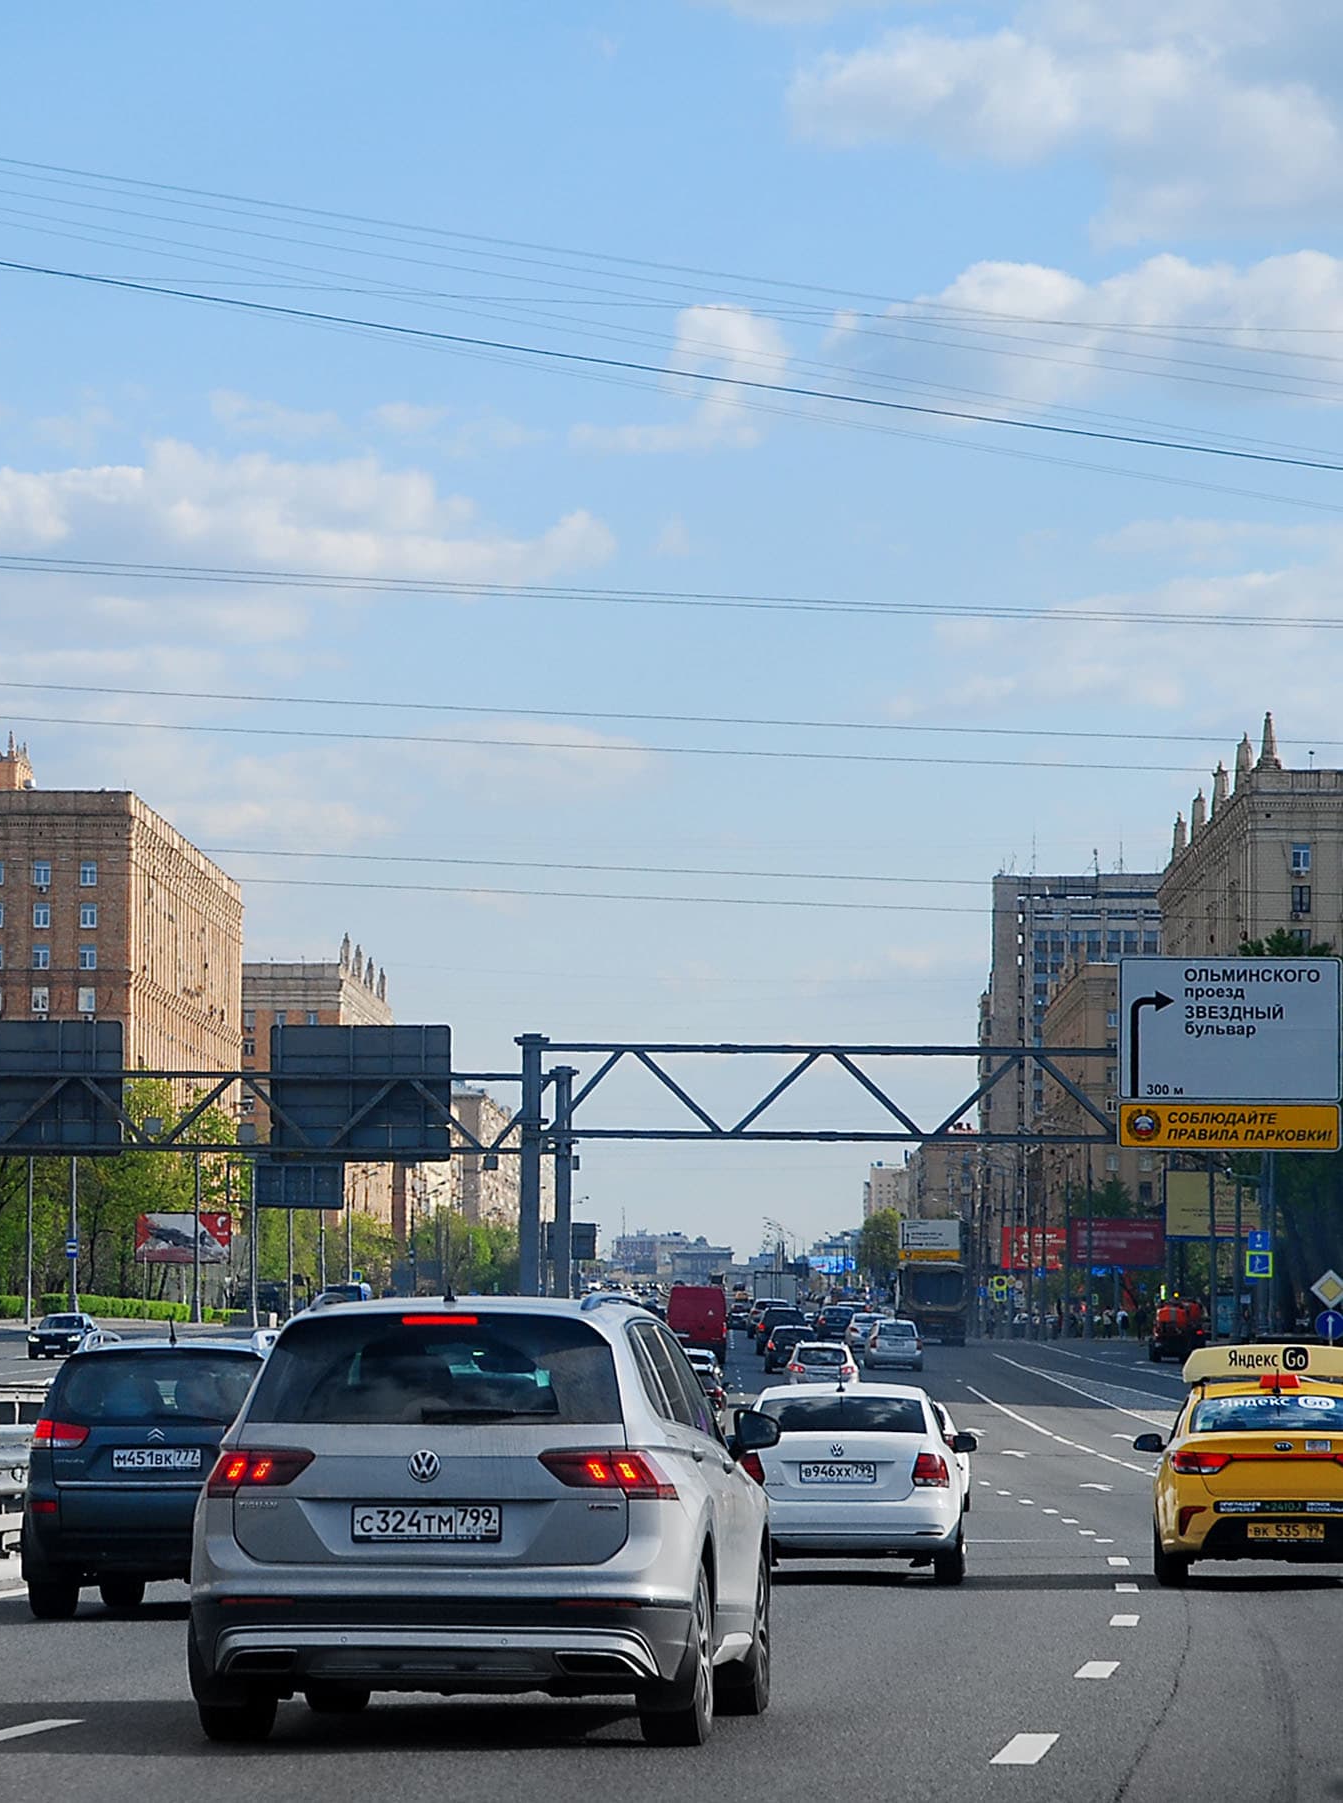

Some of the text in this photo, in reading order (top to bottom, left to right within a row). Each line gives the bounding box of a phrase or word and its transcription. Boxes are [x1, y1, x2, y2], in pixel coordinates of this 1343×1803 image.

[1184, 968, 1320, 983] ОЛЬМИНСКОГО
[1184, 987, 1245, 1000] проезд
[1184, 1004, 1284, 1020] ЗВЕЗДНЫЙ
[1184, 1022, 1257, 1038] бульвар
[1146, 1084, 1184, 1096] 300 м
[1167, 1111, 1277, 1126] СОБЛЮДАЙТЕ
[1167, 1128, 1332, 1142] ПРАВИЛА ПАРКОВКИ!
[1228, 1349, 1306, 1368] Яндекс Go
[1219, 1397, 1291, 1408] Яндекс
[458, 1508, 493, 1526] 799
[1275, 1525, 1300, 1537] 535
